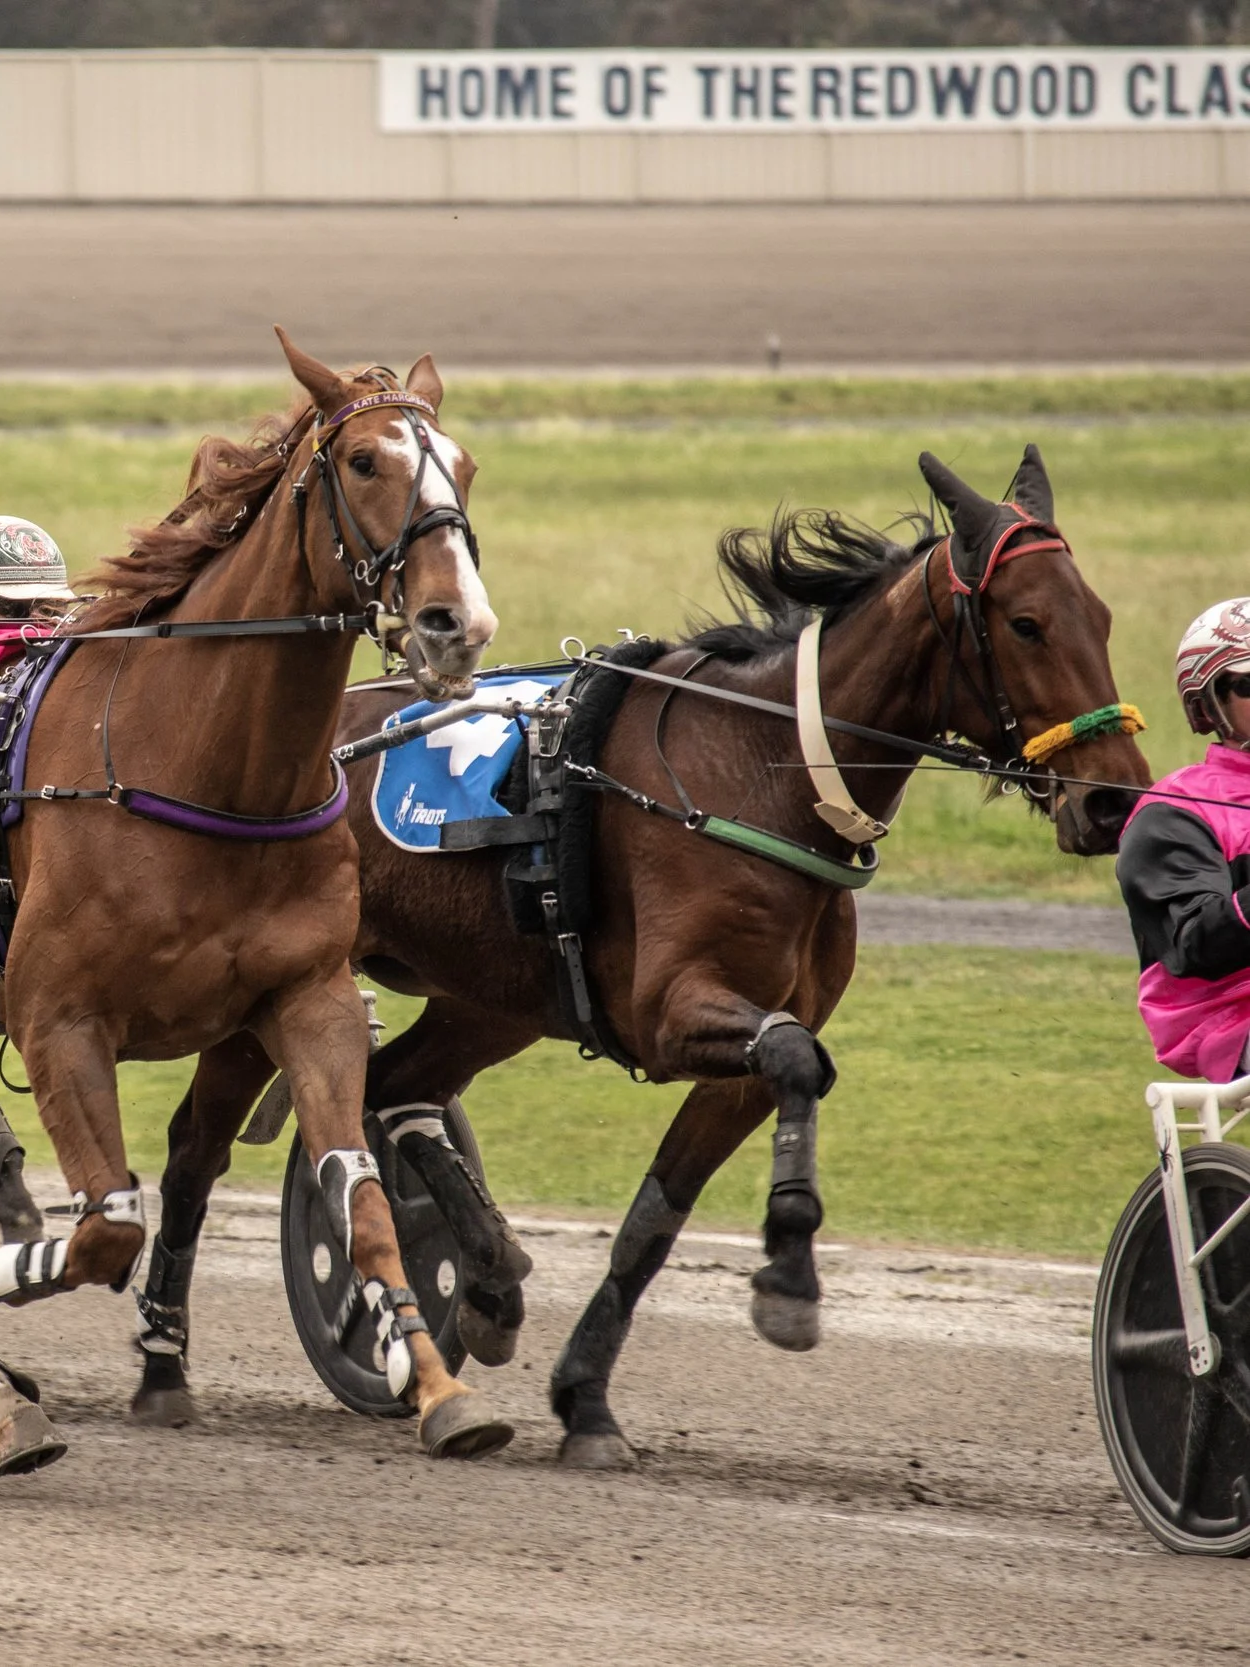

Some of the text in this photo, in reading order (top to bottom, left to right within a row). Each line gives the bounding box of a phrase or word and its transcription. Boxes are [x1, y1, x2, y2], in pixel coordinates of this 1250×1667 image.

[417, 65, 575, 119] HOME
[602, 65, 668, 119] OF
[694, 65, 796, 119] THE
[810, 63, 1098, 118] REDWOOD
[353, 395, 381, 410] KATE
[410, 808, 448, 826] TROTS
